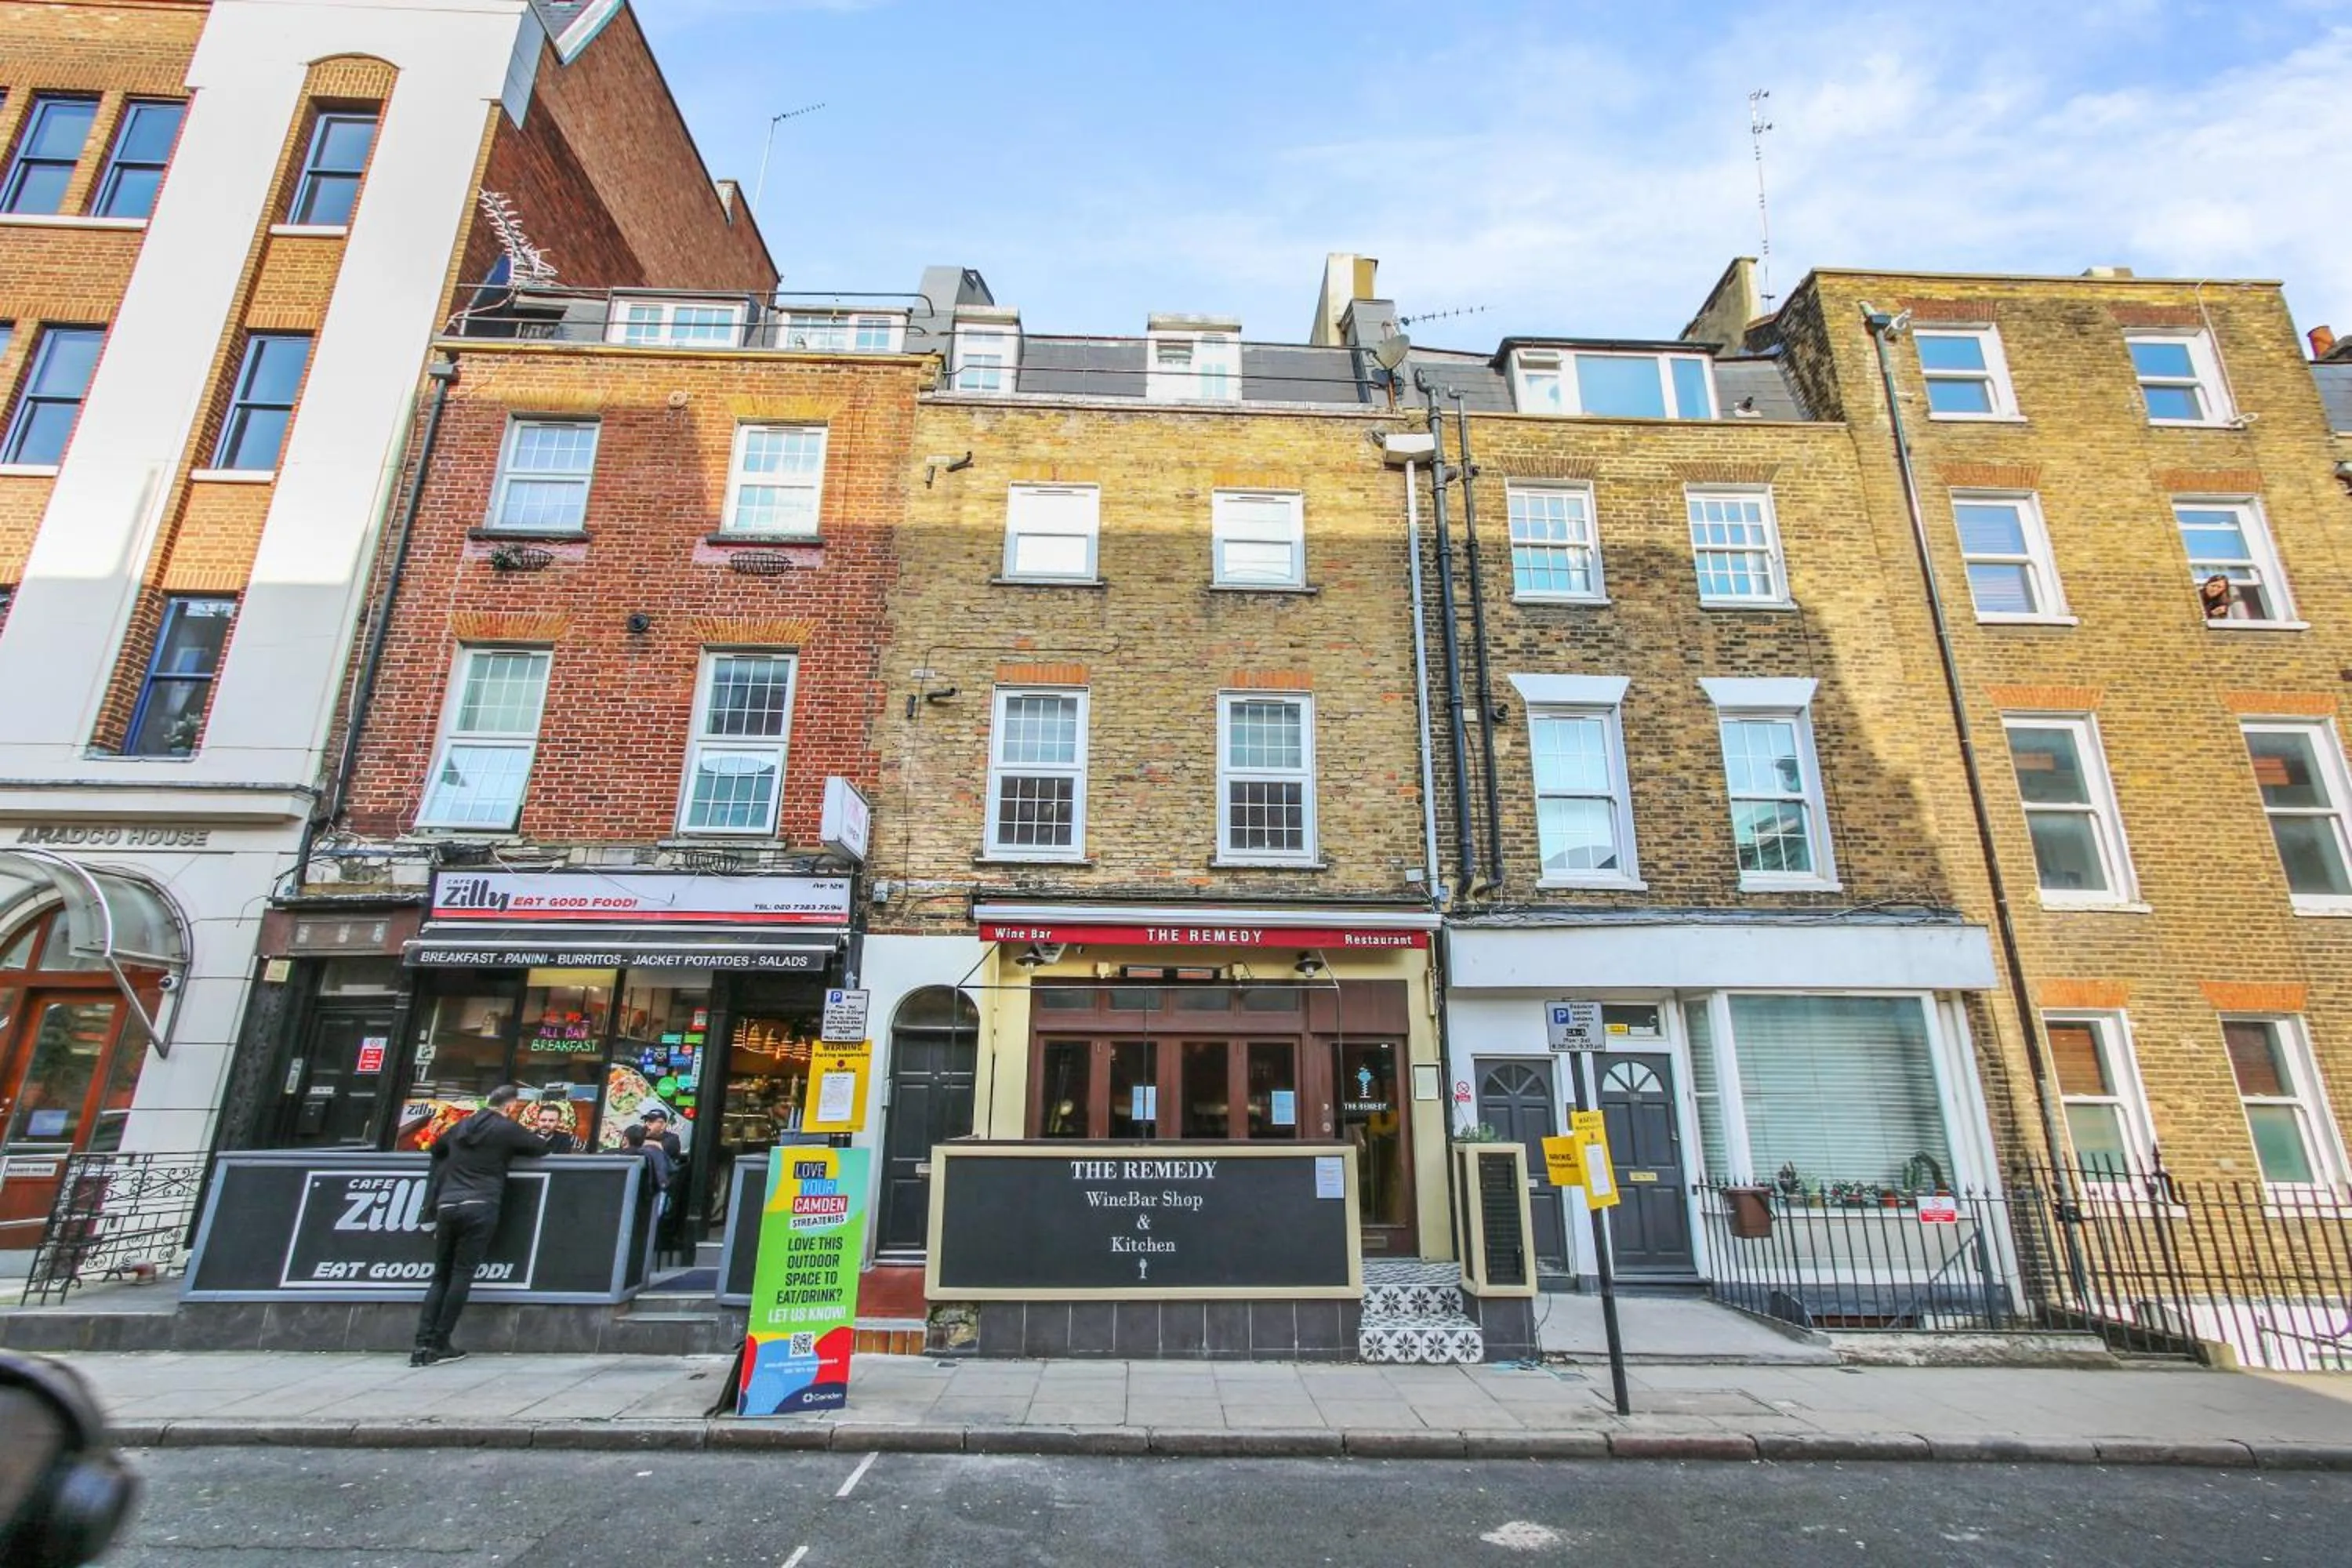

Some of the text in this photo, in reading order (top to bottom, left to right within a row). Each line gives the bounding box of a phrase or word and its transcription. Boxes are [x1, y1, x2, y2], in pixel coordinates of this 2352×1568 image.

[16, 826, 210, 847] ARADCO HOUSE
[441, 879, 638, 913] Zilly EAT GOOD FOOD!
[995, 928, 1051, 939] Wine Bar
[1148, 928, 1262, 942] THE REMEDY
[1345, 934, 1412, 945] Restaurant
[420, 951, 498, 964] BREAKFAST
[504, 953, 548, 964] PANINI
[557, 953, 622, 965] BURRITOS
[632, 954, 681, 966] JACKET
[684, 955, 749, 966] POTATOES
[758, 956, 808, 967] SALADS
[539, 1025, 588, 1039] ALL DAY
[531, 1039, 598, 1052] BREAKFAST
[796, 1163, 826, 1178] LOVE
[1071, 1161, 1218, 1179] THE REMEDY
[349, 1178, 395, 1189] CAFE
[804, 1180, 835, 1195] YOUR
[334, 1179, 437, 1232] Zill
[794, 1197, 846, 1213] CAMDEN
[1086, 1190, 1203, 1211] WineBar Shop
[793, 1214, 844, 1229] STREATERIES
[1137, 1214, 1151, 1230] &
[788, 1236, 843, 1251] LOVE THIS
[1111, 1236, 1176, 1253] Kitchen
[787, 1254, 840, 1269] OUTDOOR
[313, 1261, 514, 1279] EAT GOOD OD!
[786, 1271, 838, 1286] SPACE TO
[776, 1288, 843, 1305] EAT/DRINK?
[768, 1305, 846, 1323] LET US KNOW!
[813, 1392, 842, 1401] Camden
